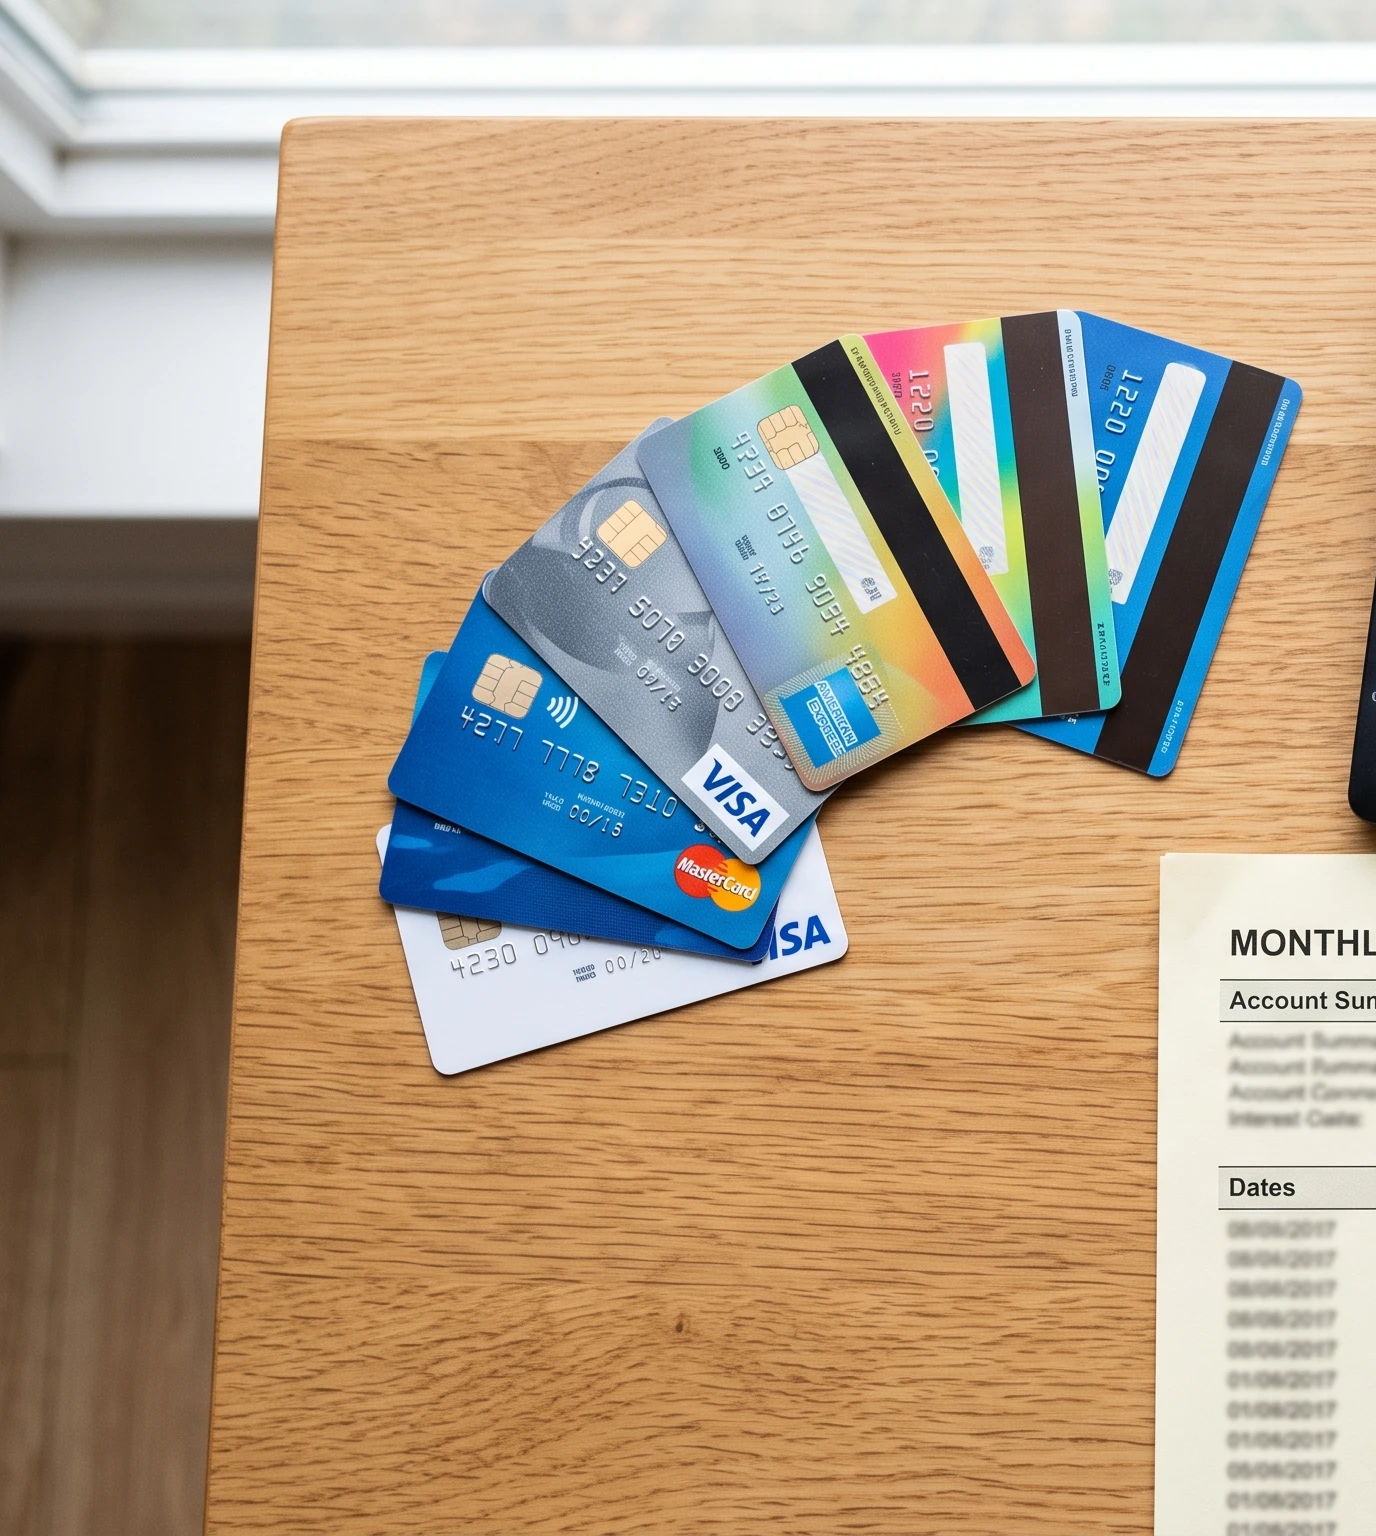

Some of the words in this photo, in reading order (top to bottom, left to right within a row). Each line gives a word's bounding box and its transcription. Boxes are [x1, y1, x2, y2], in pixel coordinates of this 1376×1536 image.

[909, 369, 935, 432] 1220
[1104, 369, 1144, 435] 1220
[541, 738, 600, 784] 7778
[620, 772, 678, 819] 7310
[702, 757, 772, 838] VISA
[450, 943, 517, 979] 4230
[760, 914, 831, 962] ISA
[1230, 991, 1327, 1009] Account
[1230, 1178, 1295, 1196] Dates
